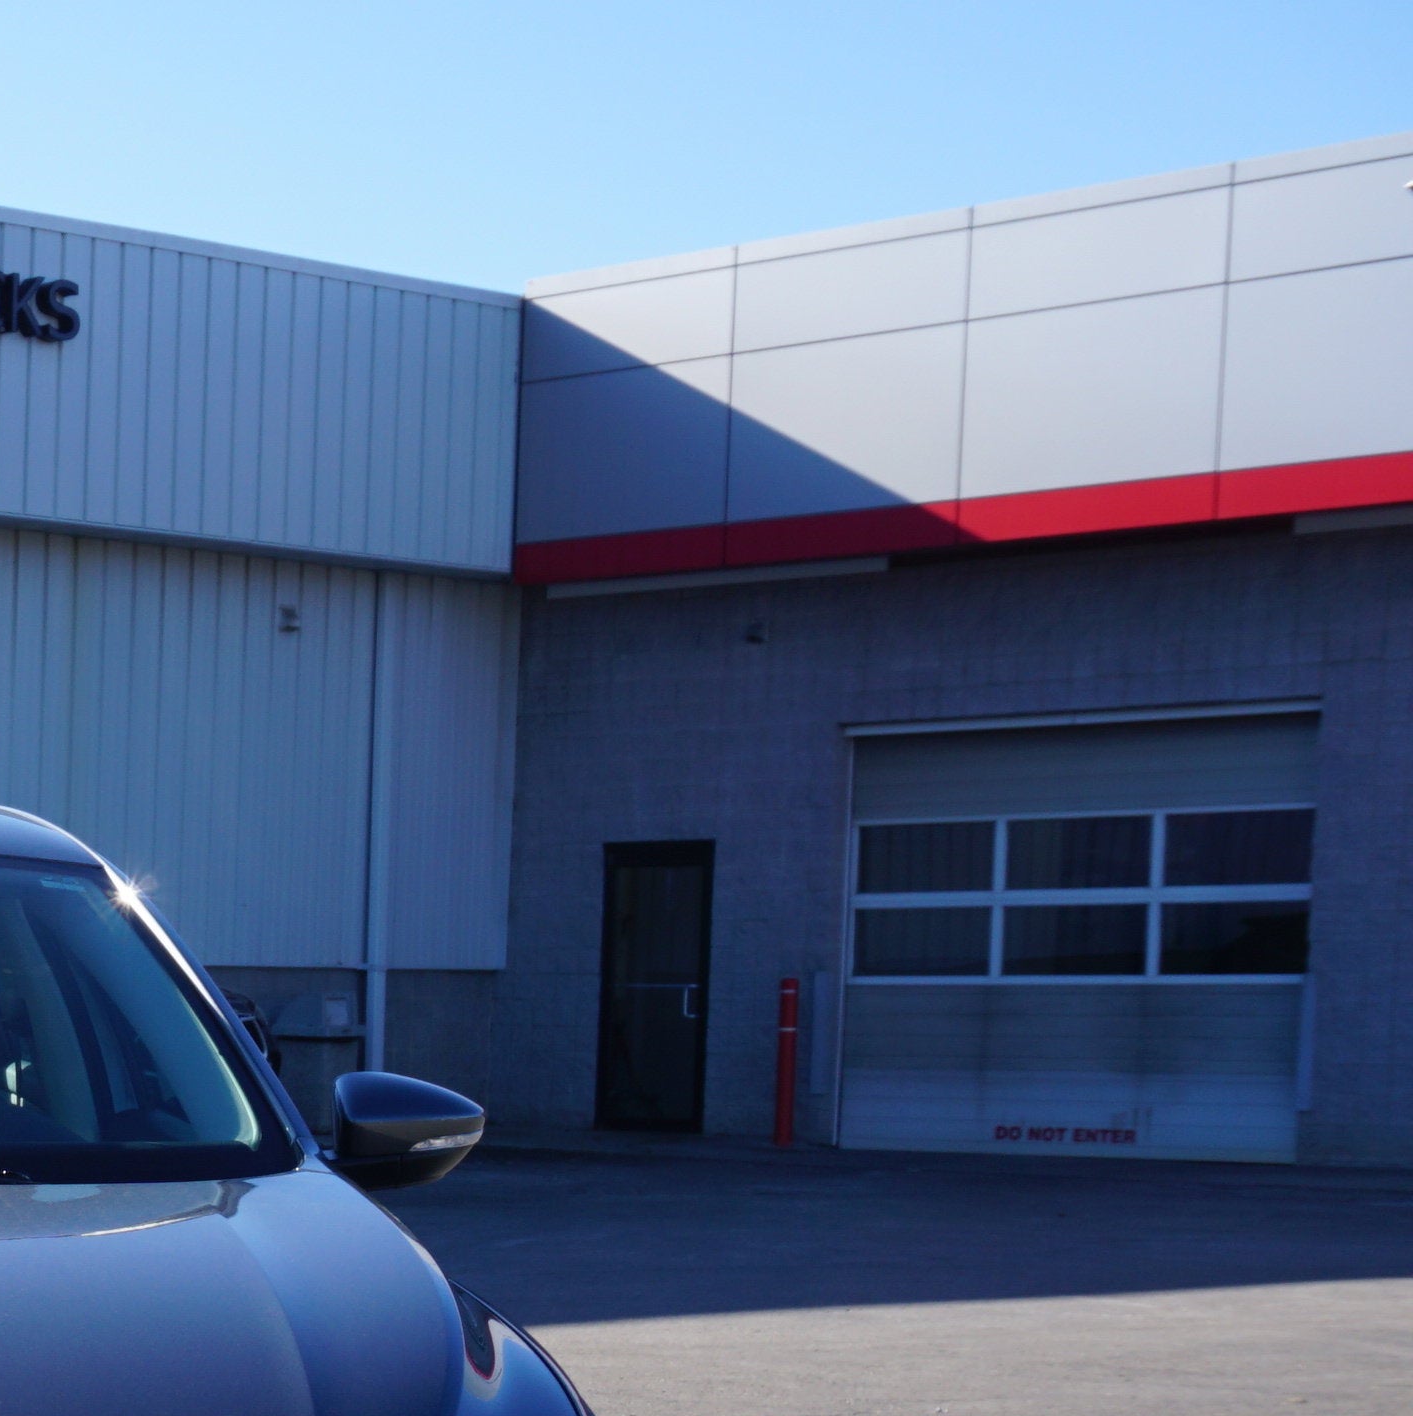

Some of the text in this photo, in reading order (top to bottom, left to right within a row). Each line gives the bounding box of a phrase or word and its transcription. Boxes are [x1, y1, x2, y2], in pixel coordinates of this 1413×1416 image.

[995, 1126, 1136, 1143] DO NOT ENTER
